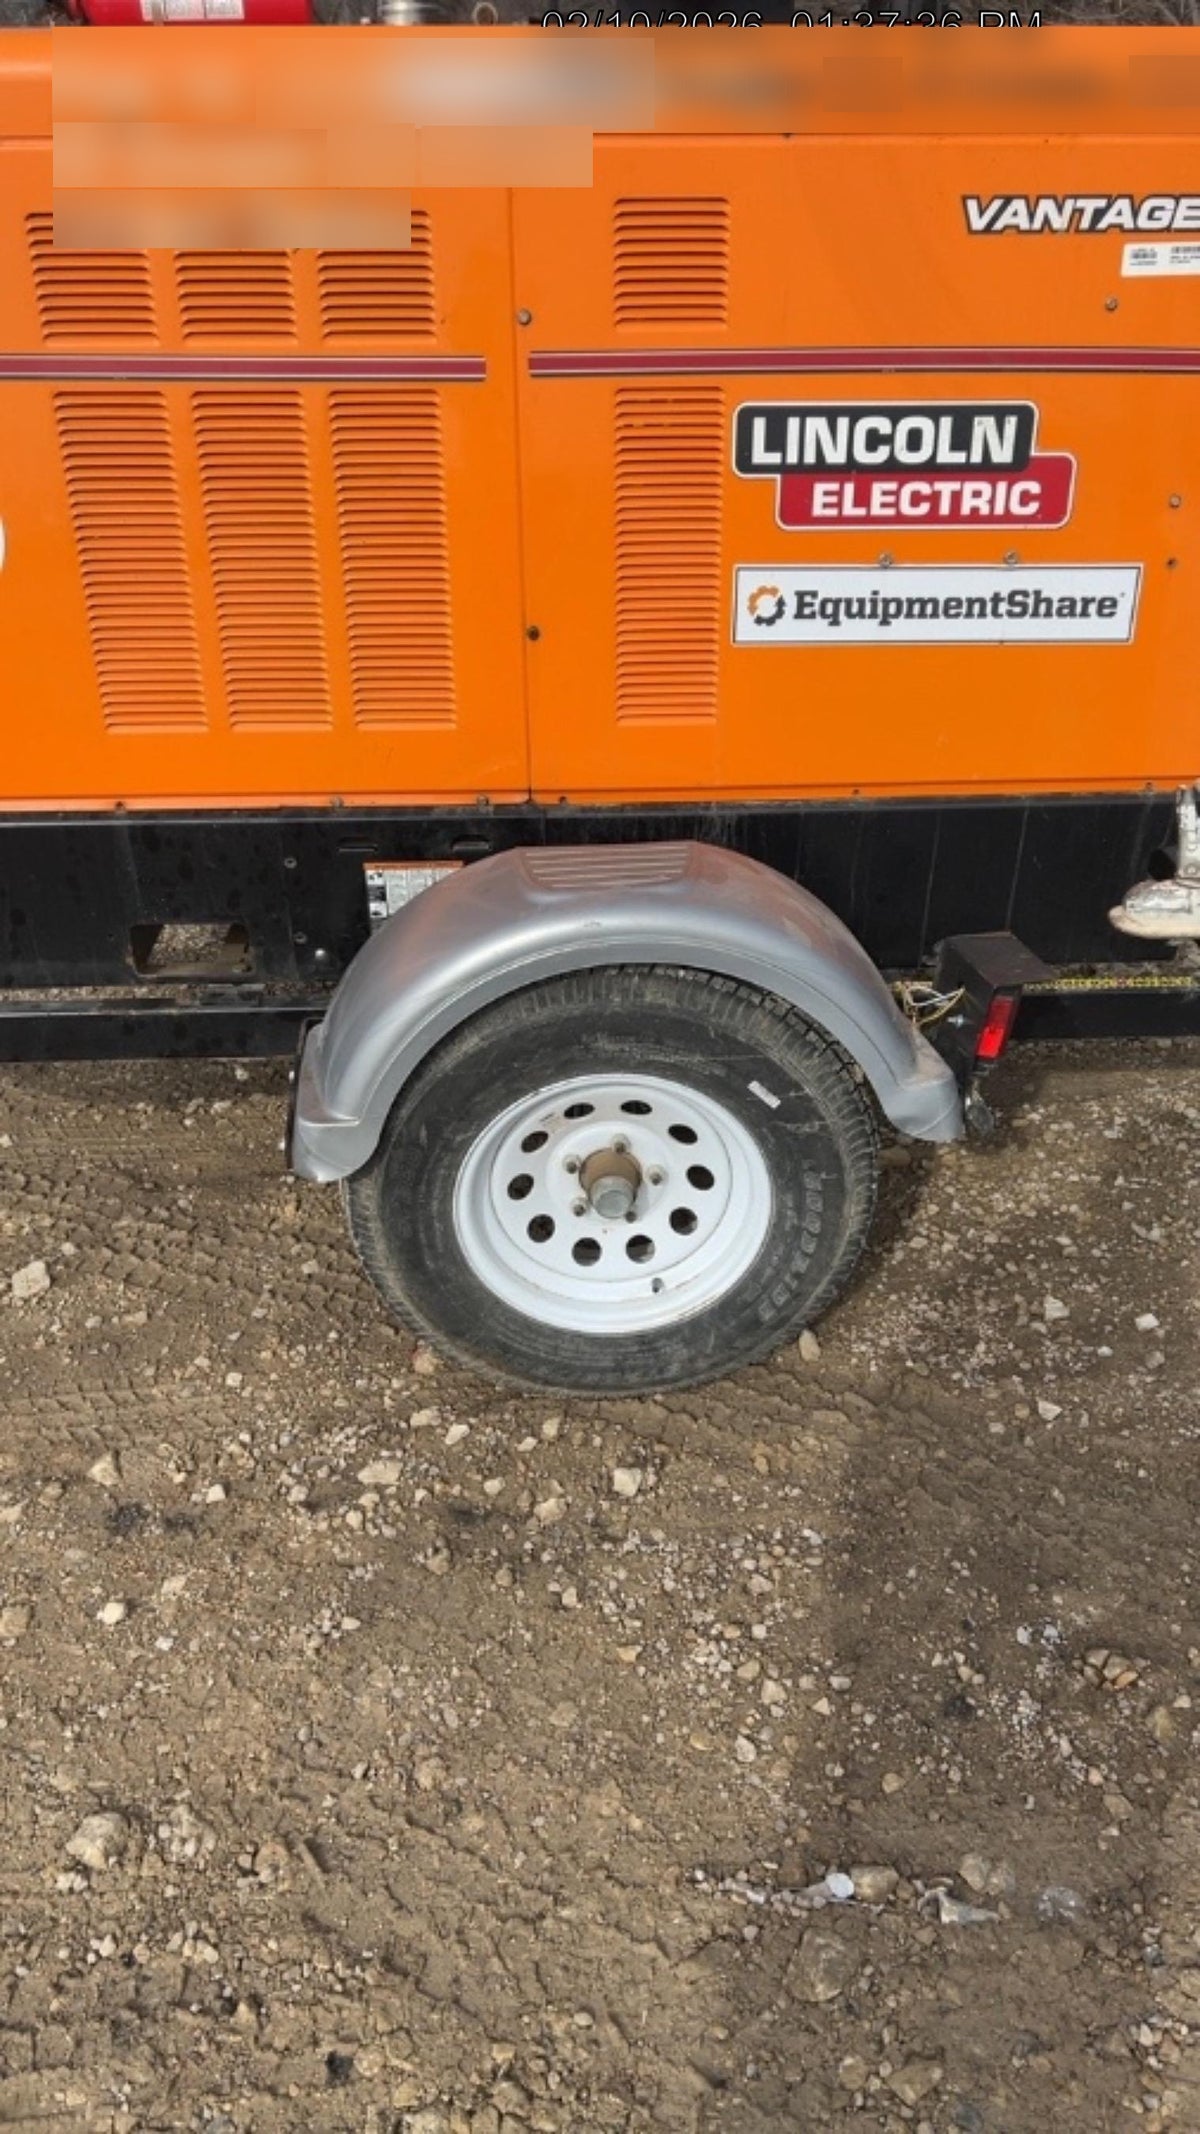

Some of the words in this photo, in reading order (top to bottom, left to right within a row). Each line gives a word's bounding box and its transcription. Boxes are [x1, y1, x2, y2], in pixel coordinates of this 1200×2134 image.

[963, 196, 1200, 233] VANTAGE
[750, 415, 1018, 466] LINCOLN
[810, 480, 1043, 518] ELECTRIC
[793, 589, 1118, 626] EquipmentShare
